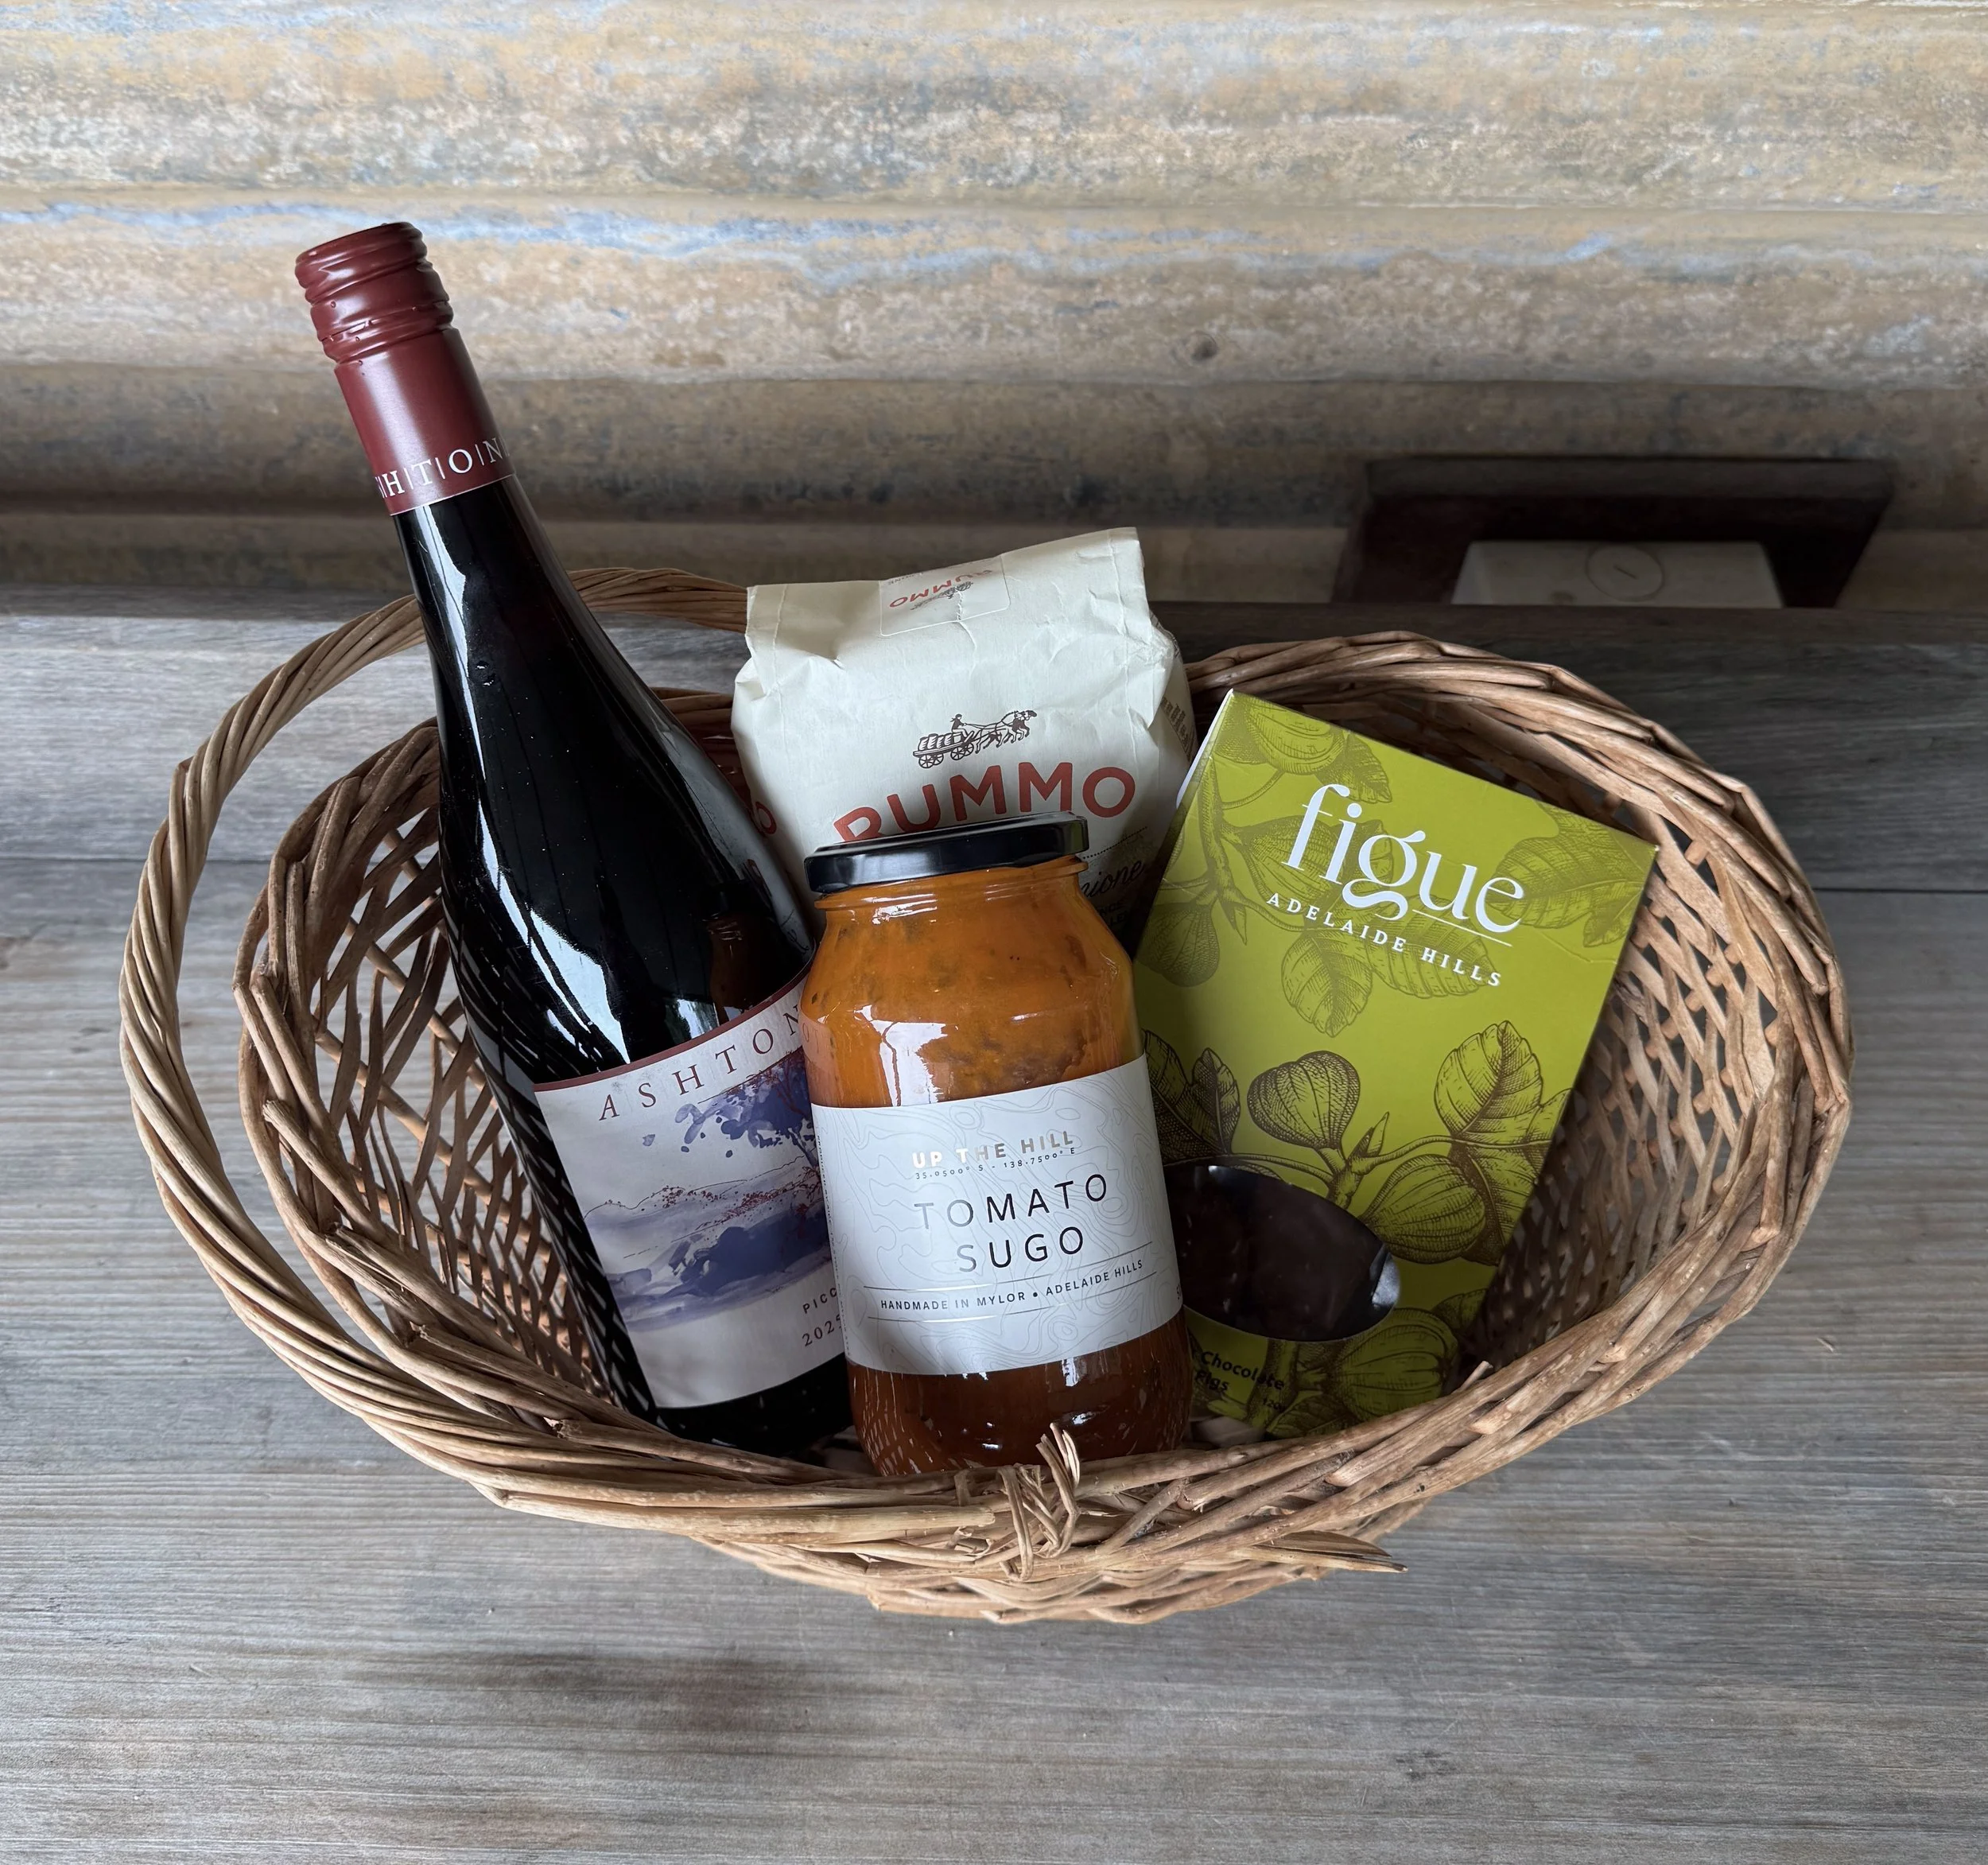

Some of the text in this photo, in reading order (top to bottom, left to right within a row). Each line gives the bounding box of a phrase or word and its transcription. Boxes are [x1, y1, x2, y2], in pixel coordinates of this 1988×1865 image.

[833, 762, 1136, 843] RUMMO
[1281, 783, 1524, 933] figue
[1267, 892, 1501, 987] ADELAIDE HILLS
[599, 1004, 799, 1121] ASHTON
[912, 1131, 1074, 1169] UP THE HILL
[914, 1174, 1107, 1230] TOMATO
[957, 1226, 1083, 1272] SUGO
[881, 1260, 1143, 1311] HANDMADE IN MYLOR ADELAIDE HILLS
[1201, 1352, 1284, 1391] Chocolate
